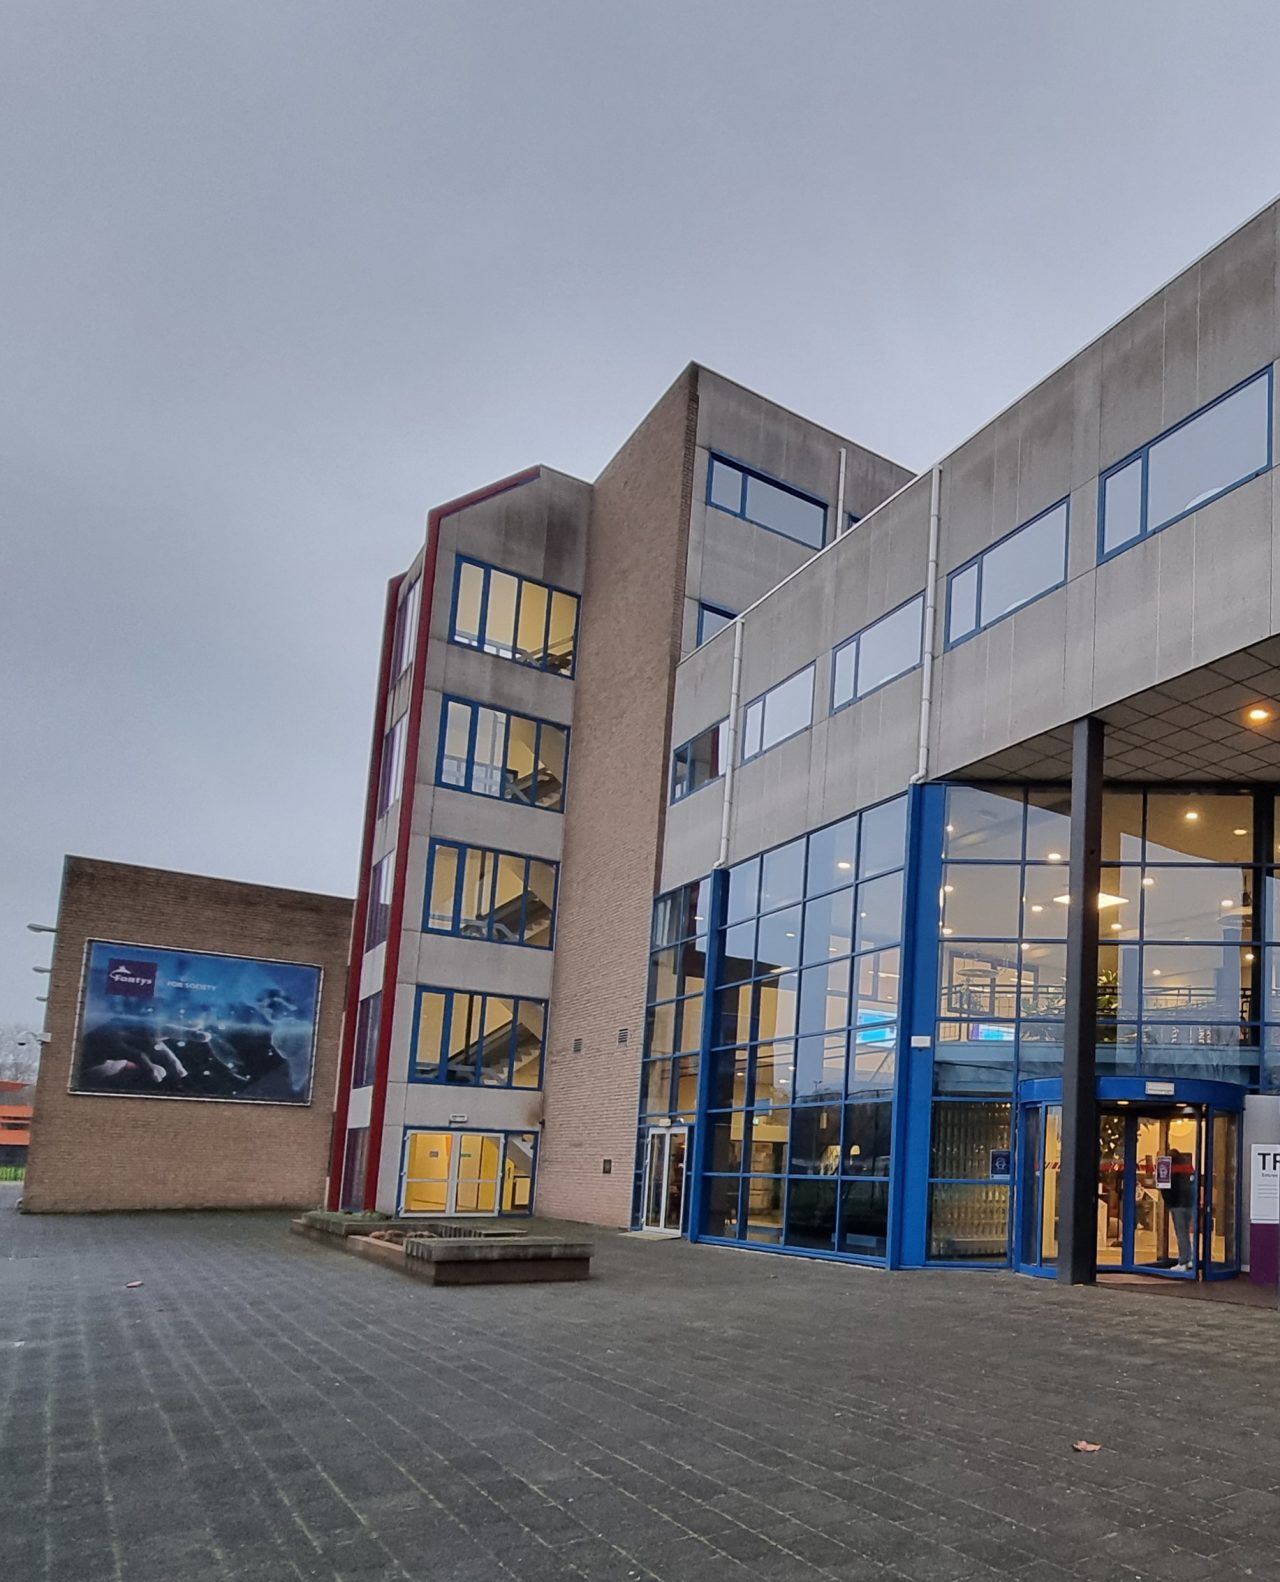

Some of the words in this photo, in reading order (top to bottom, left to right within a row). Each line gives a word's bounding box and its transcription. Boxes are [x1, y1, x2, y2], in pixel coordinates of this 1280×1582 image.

[113, 974, 152, 986] Fontys
[167, 980, 183, 988] FOR
[185, 982, 216, 991] SOCIETY
